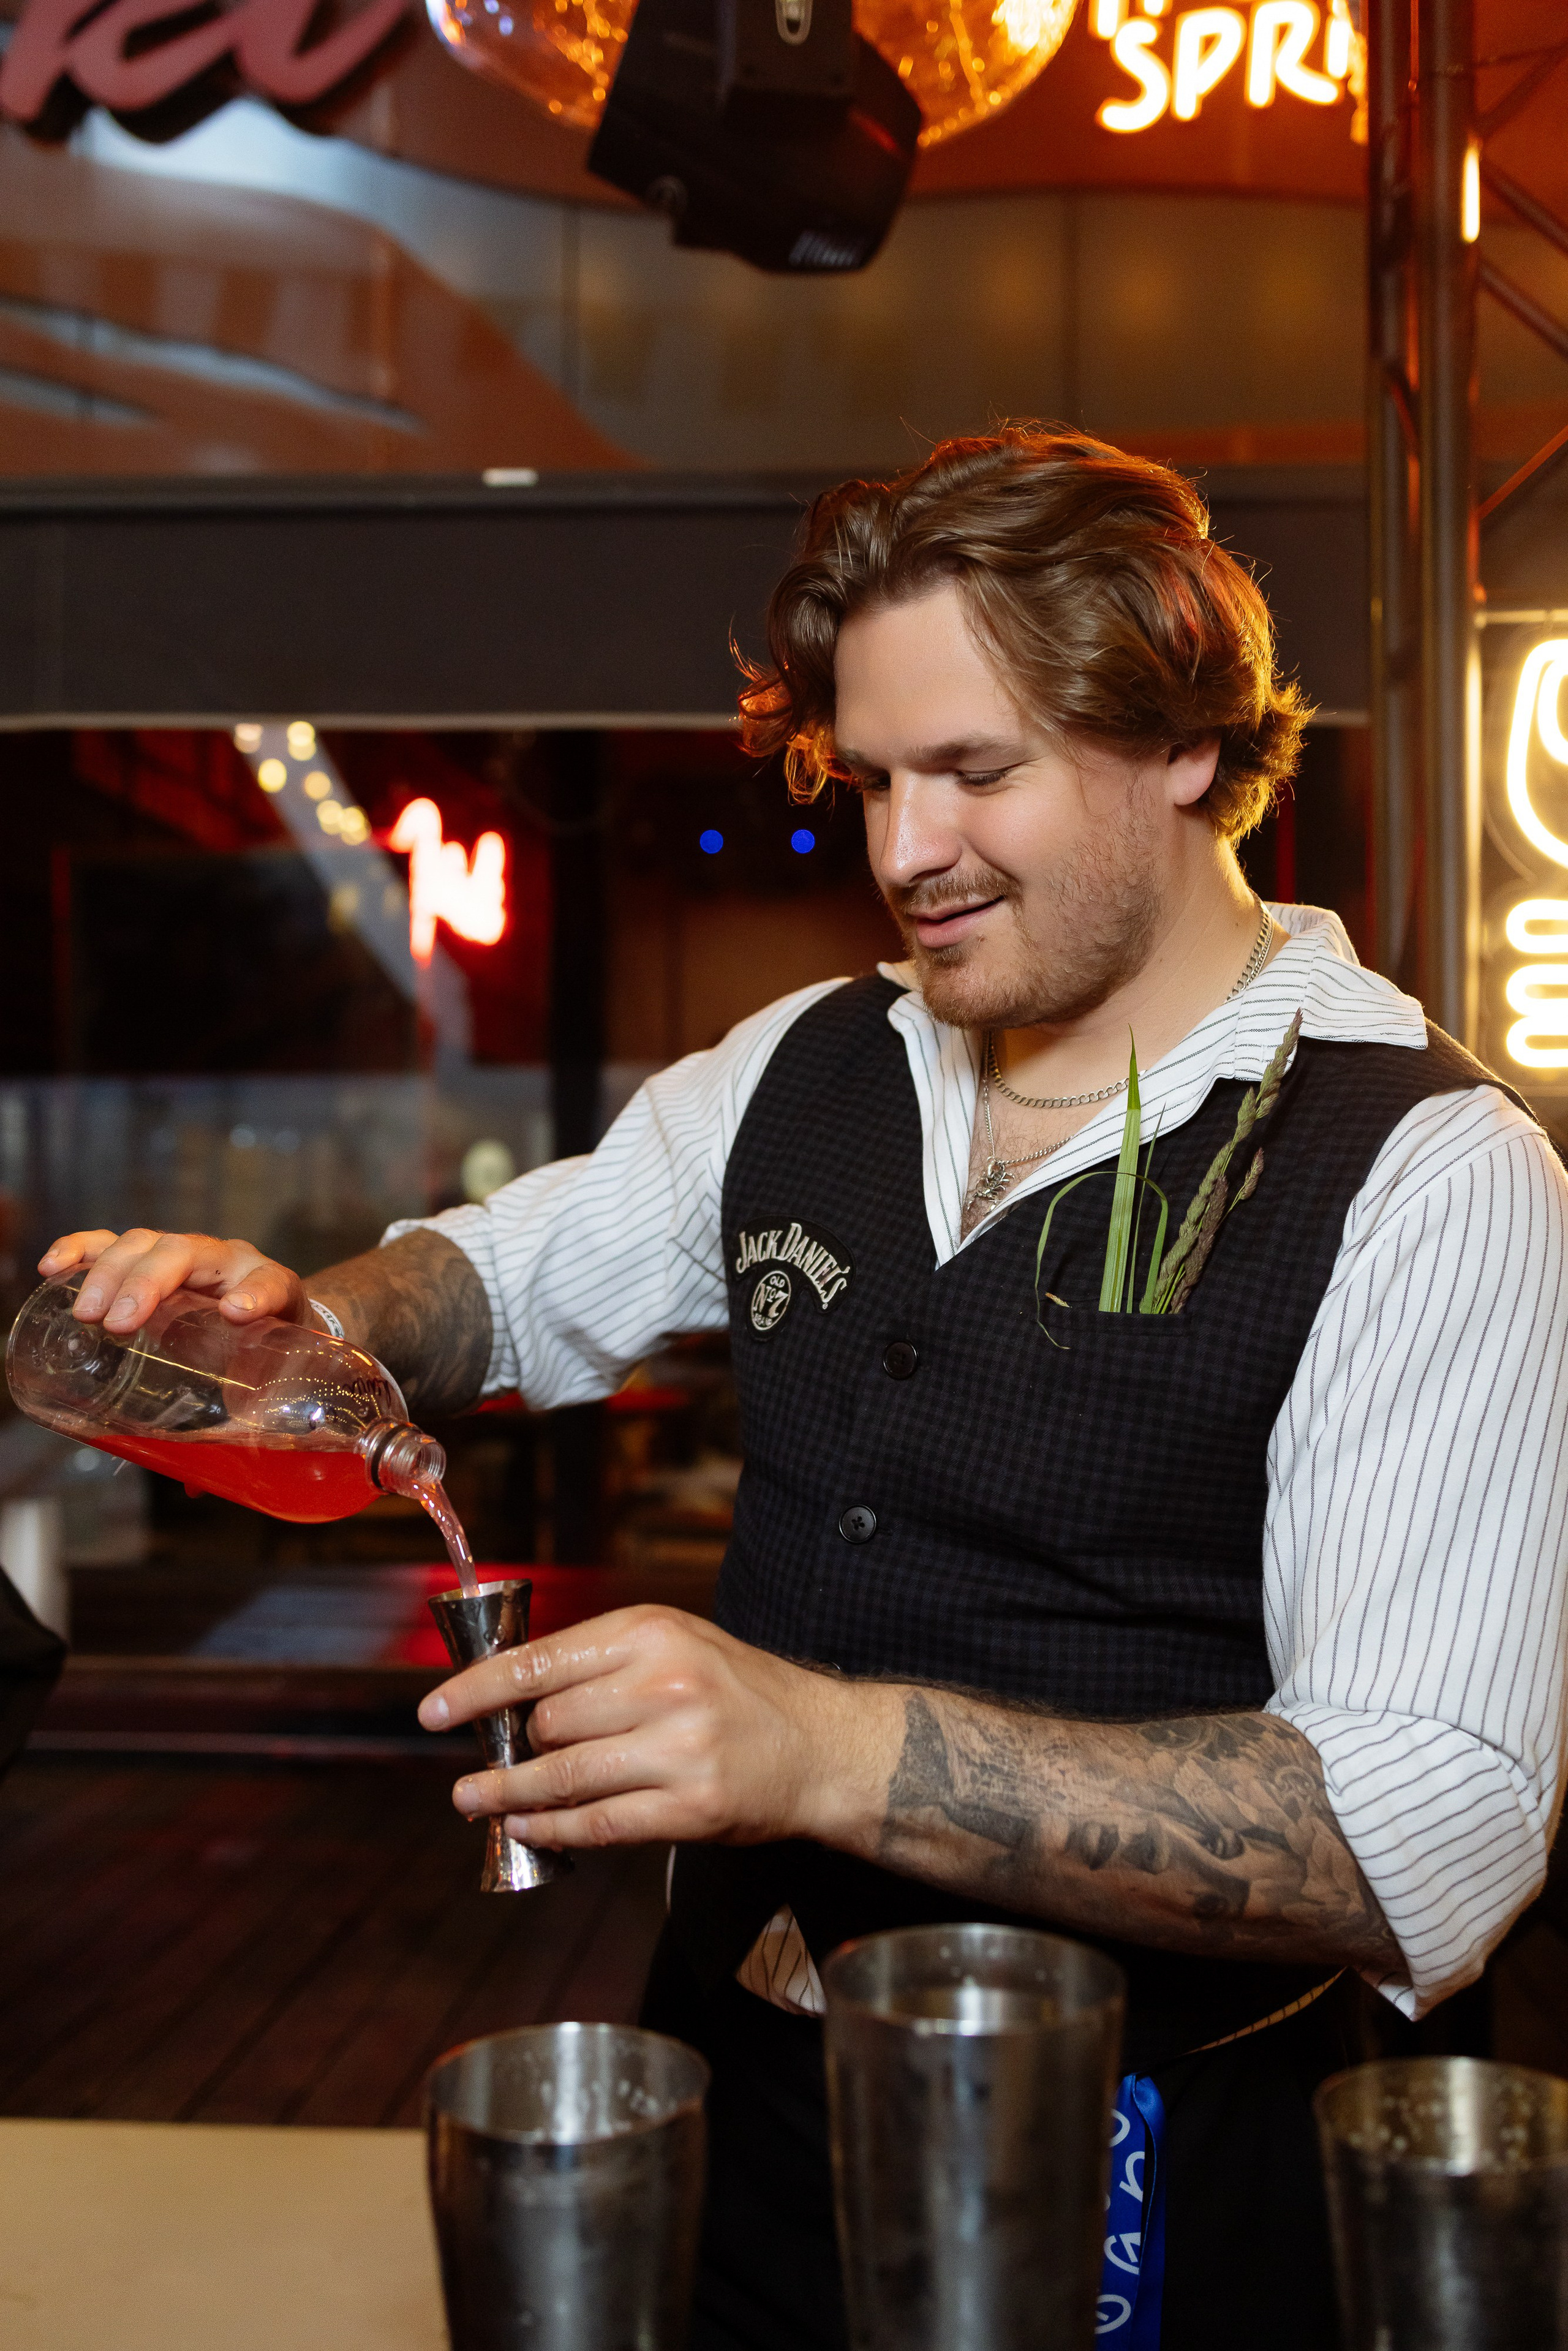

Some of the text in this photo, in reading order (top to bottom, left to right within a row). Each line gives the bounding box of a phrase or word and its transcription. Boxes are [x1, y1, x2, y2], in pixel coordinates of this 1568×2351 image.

[736, 1222, 851, 1304] JACK DANIEL'S
[769, 1275, 786, 1288] OLD
[767, 1289, 790, 1318] 7
